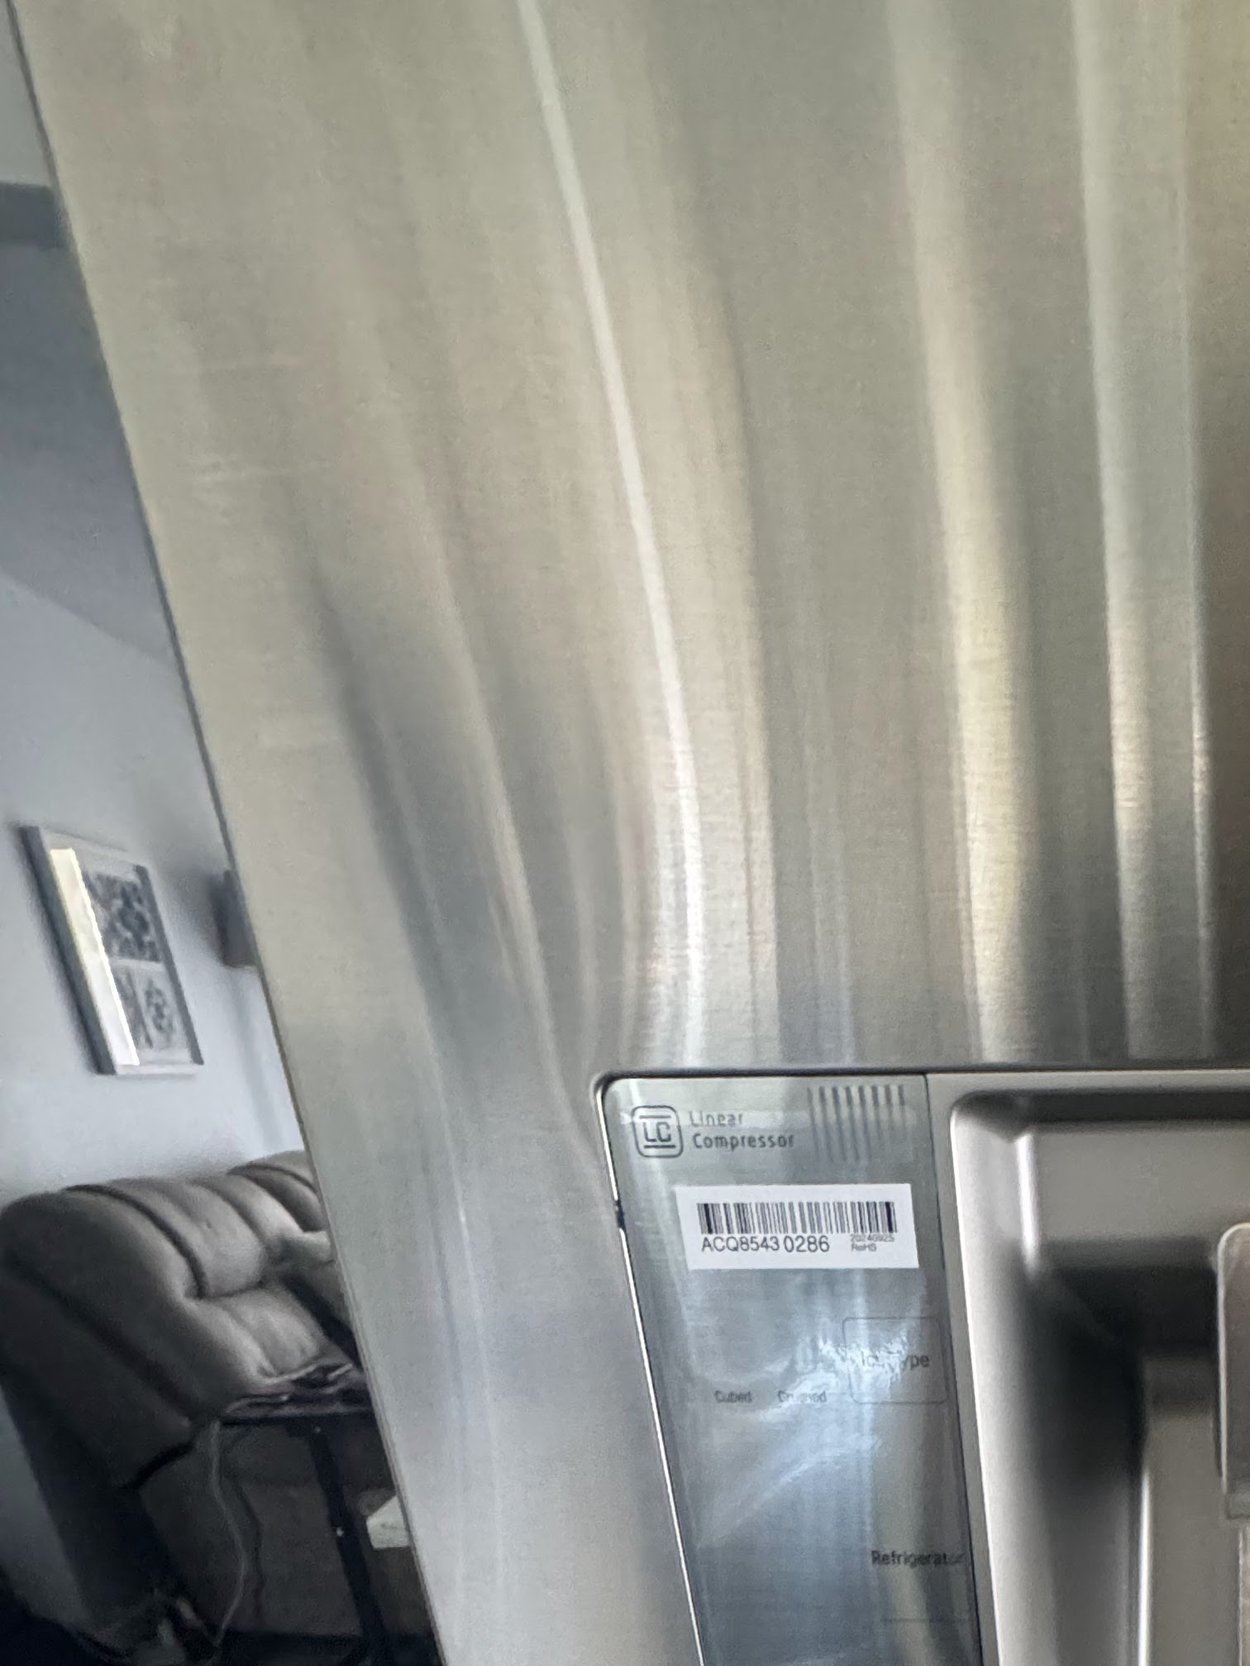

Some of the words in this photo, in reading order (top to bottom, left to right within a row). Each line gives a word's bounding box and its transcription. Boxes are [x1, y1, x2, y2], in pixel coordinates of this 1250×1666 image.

[688, 1110, 744, 1128] Linear
[642, 1121, 672, 1143] LC
[692, 1132, 795, 1152] Compressor
